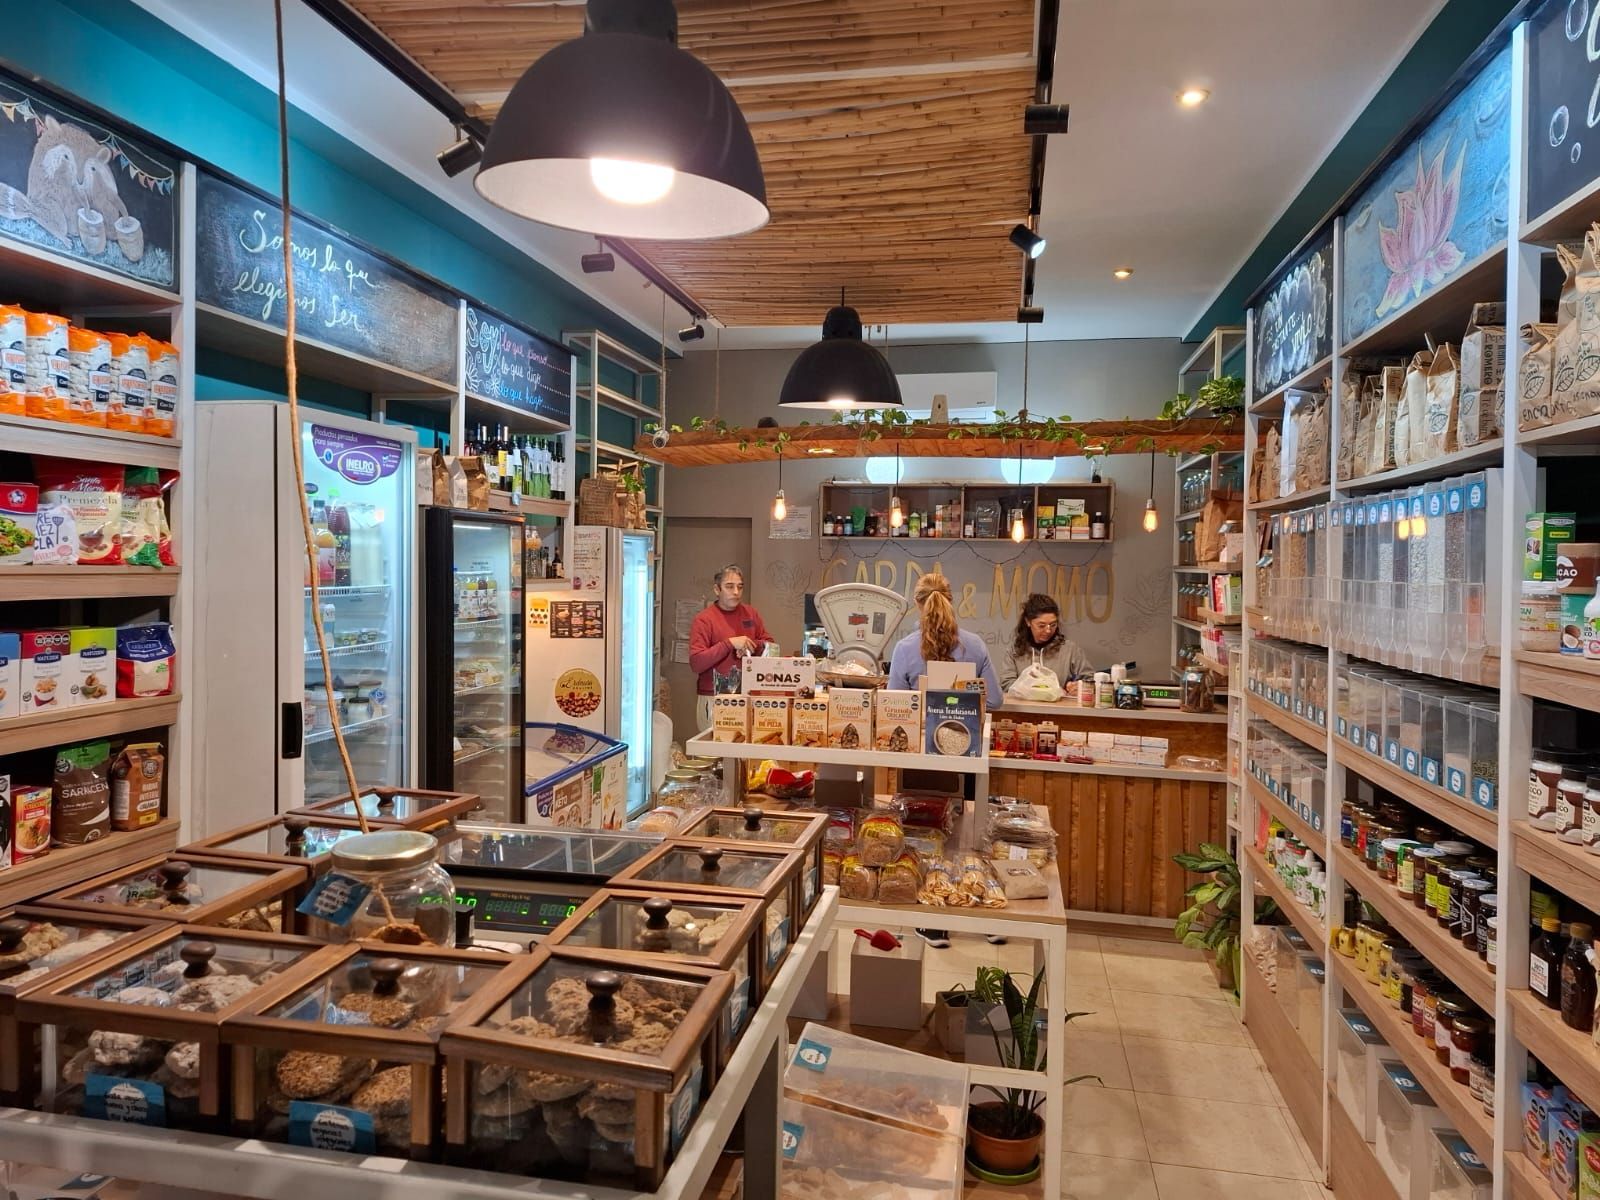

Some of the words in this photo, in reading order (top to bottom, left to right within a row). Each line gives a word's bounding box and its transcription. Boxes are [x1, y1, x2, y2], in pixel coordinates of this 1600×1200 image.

[1484, 344, 1494, 385] ROMERO
[346, 458, 374, 472] INELRO
[957, 582, 977, 619] &
[989, 560, 1115, 624] MOMO
[756, 673, 801, 683] DONAS
[884, 706, 912, 714] Granola
[927, 705, 944, 715] Avena
[945, 706, 977, 716] Tradicional
